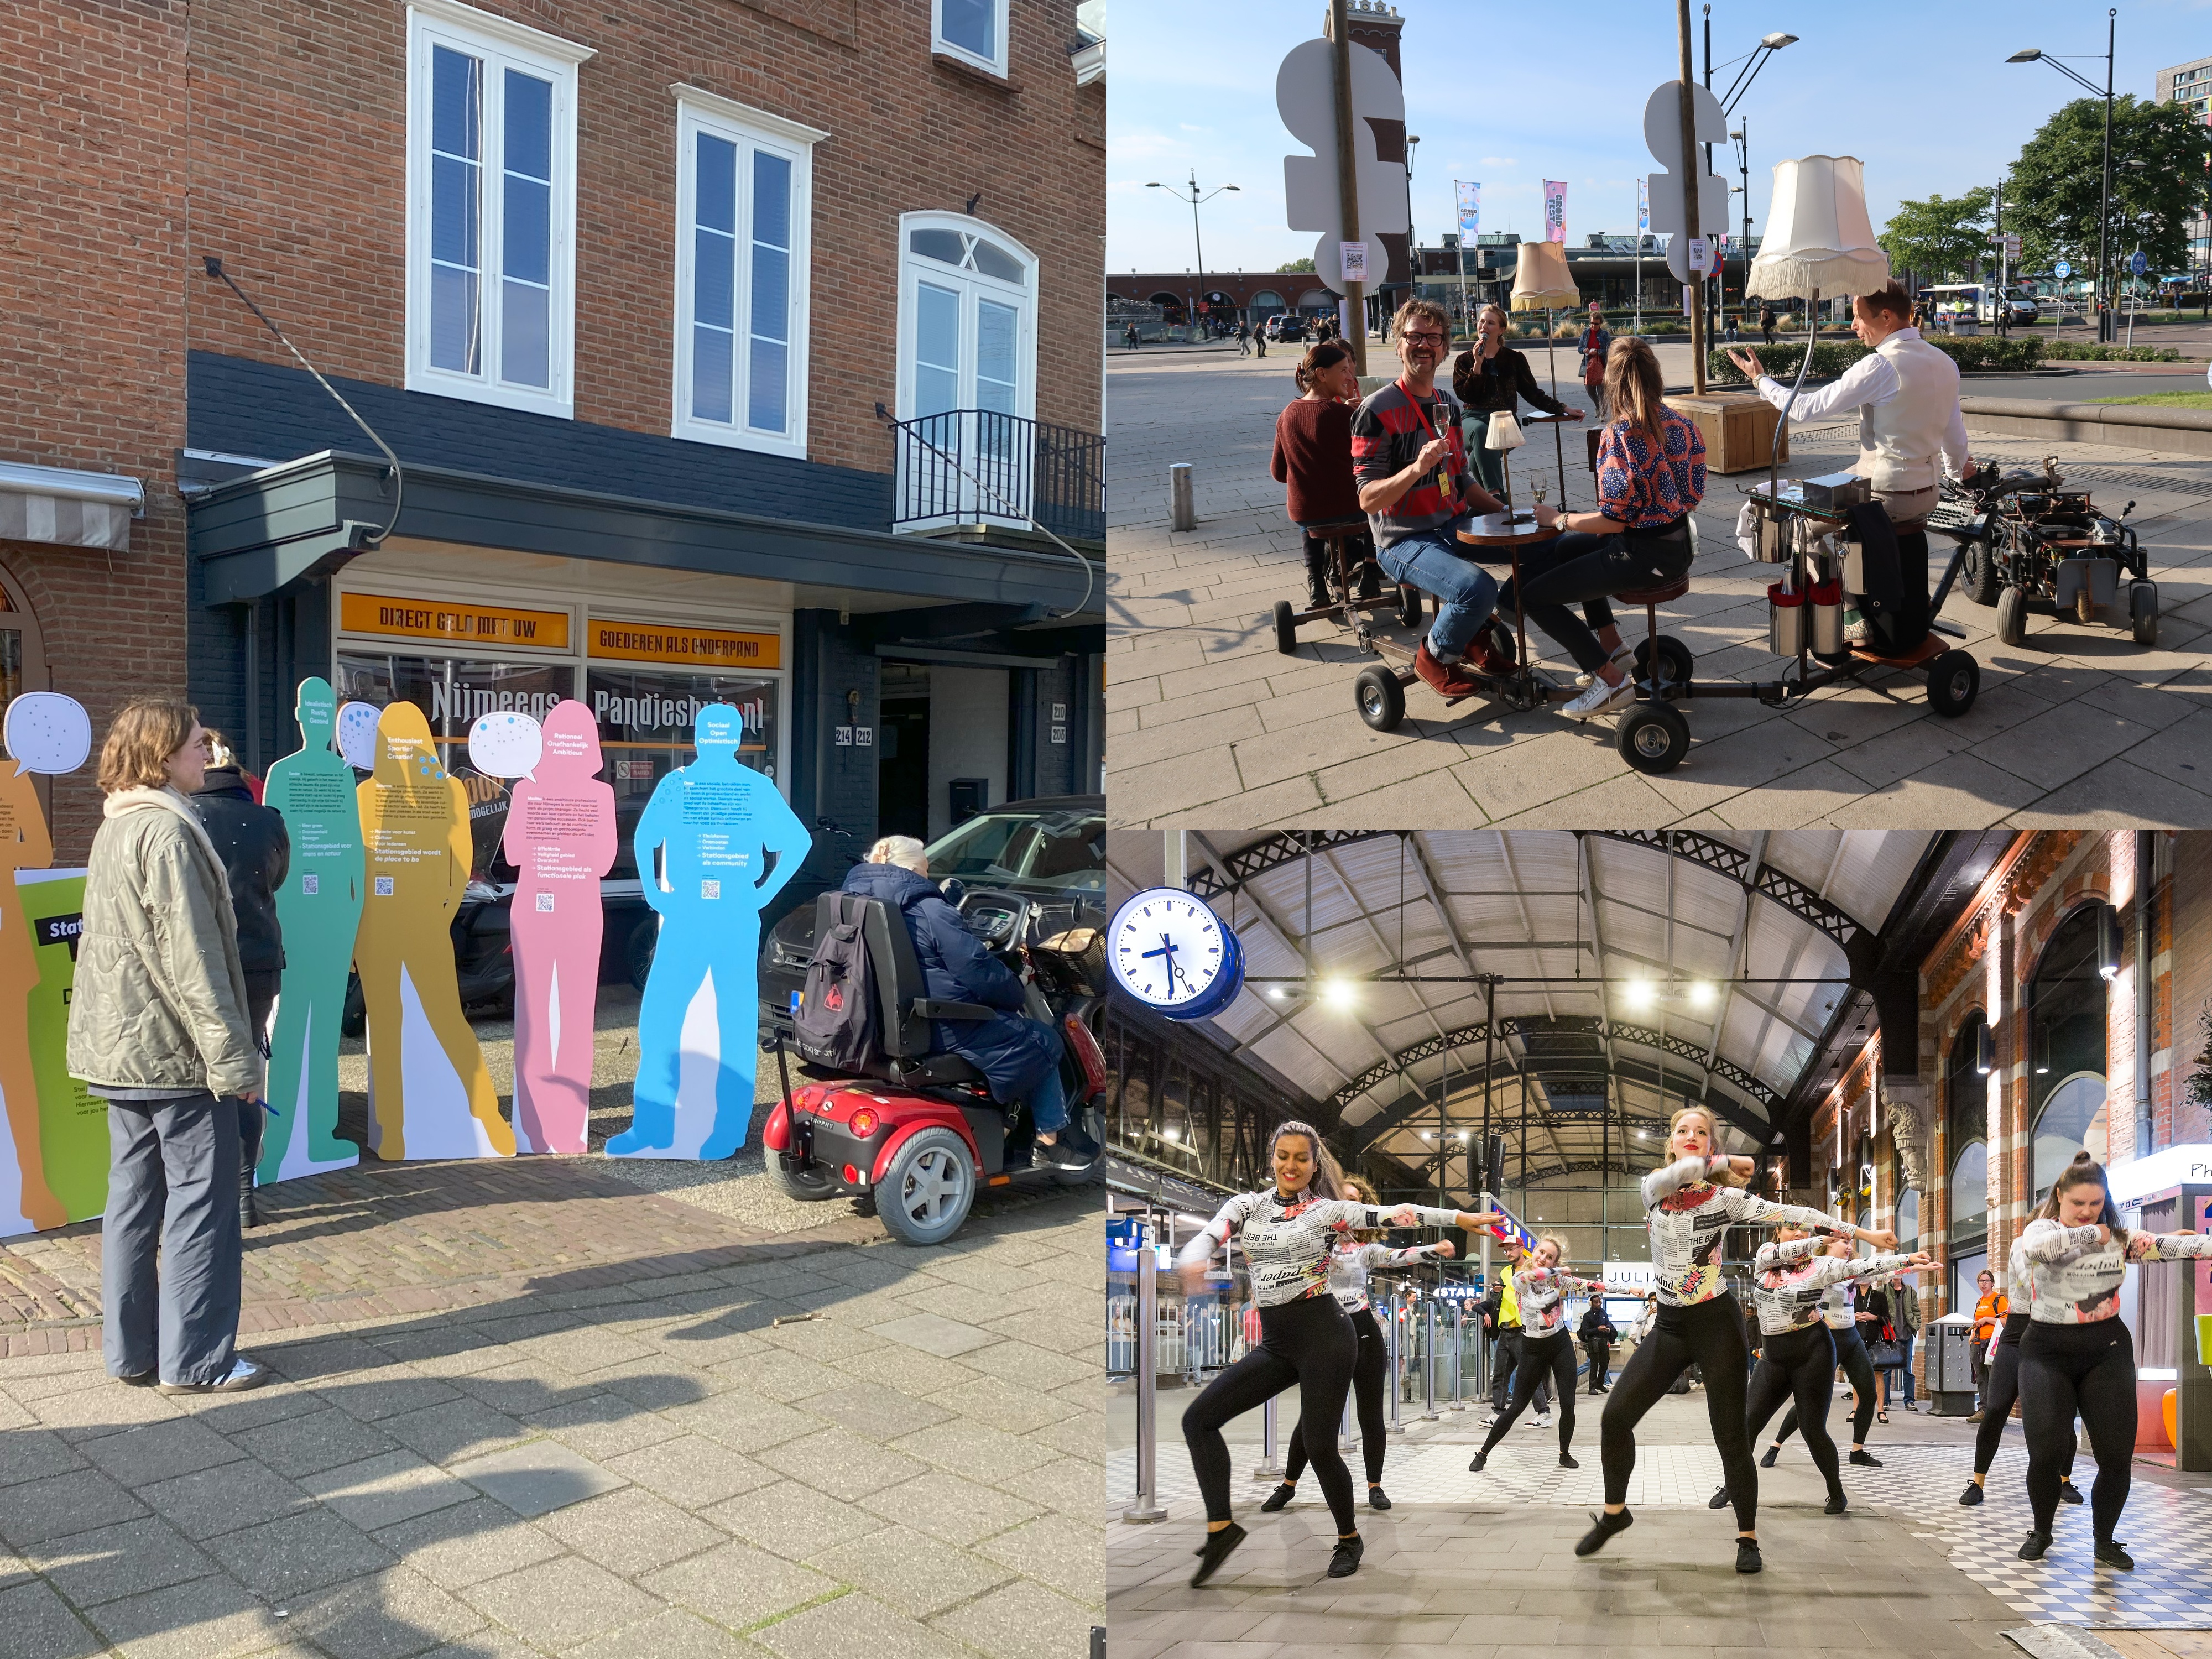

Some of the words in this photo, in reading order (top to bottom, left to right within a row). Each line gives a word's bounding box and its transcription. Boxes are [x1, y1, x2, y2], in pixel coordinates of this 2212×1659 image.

[380, 607, 434, 629] DIRECT
[437, 612, 473, 632] GELD
[477, 616, 509, 635] MET
[514, 619, 536, 638] UW
[600, 630, 662, 653] GOEDEREN
[666, 637, 688, 654] ALS
[692, 638, 758, 659] ONDERPAND
[594, 690, 764, 735] Pandjeshnl
[1053, 706, 1065, 718] 210
[836, 730, 851, 743] 214
[857, 731, 871, 743] 212
[1053, 729, 1065, 740] 208
[547, 740, 588, 749] Onafhankelijk
[537, 865, 582, 873] Stationsgebied
[50, 919, 83, 937] Stat
[810, 1117, 834, 1129] TROPHY
[1244, 1232, 1260, 1241] BEST
[1689, 1236, 1703, 1245] THE
[1261, 1267, 1302, 1281] paper
[1609, 1272, 1656, 1282] JULI
